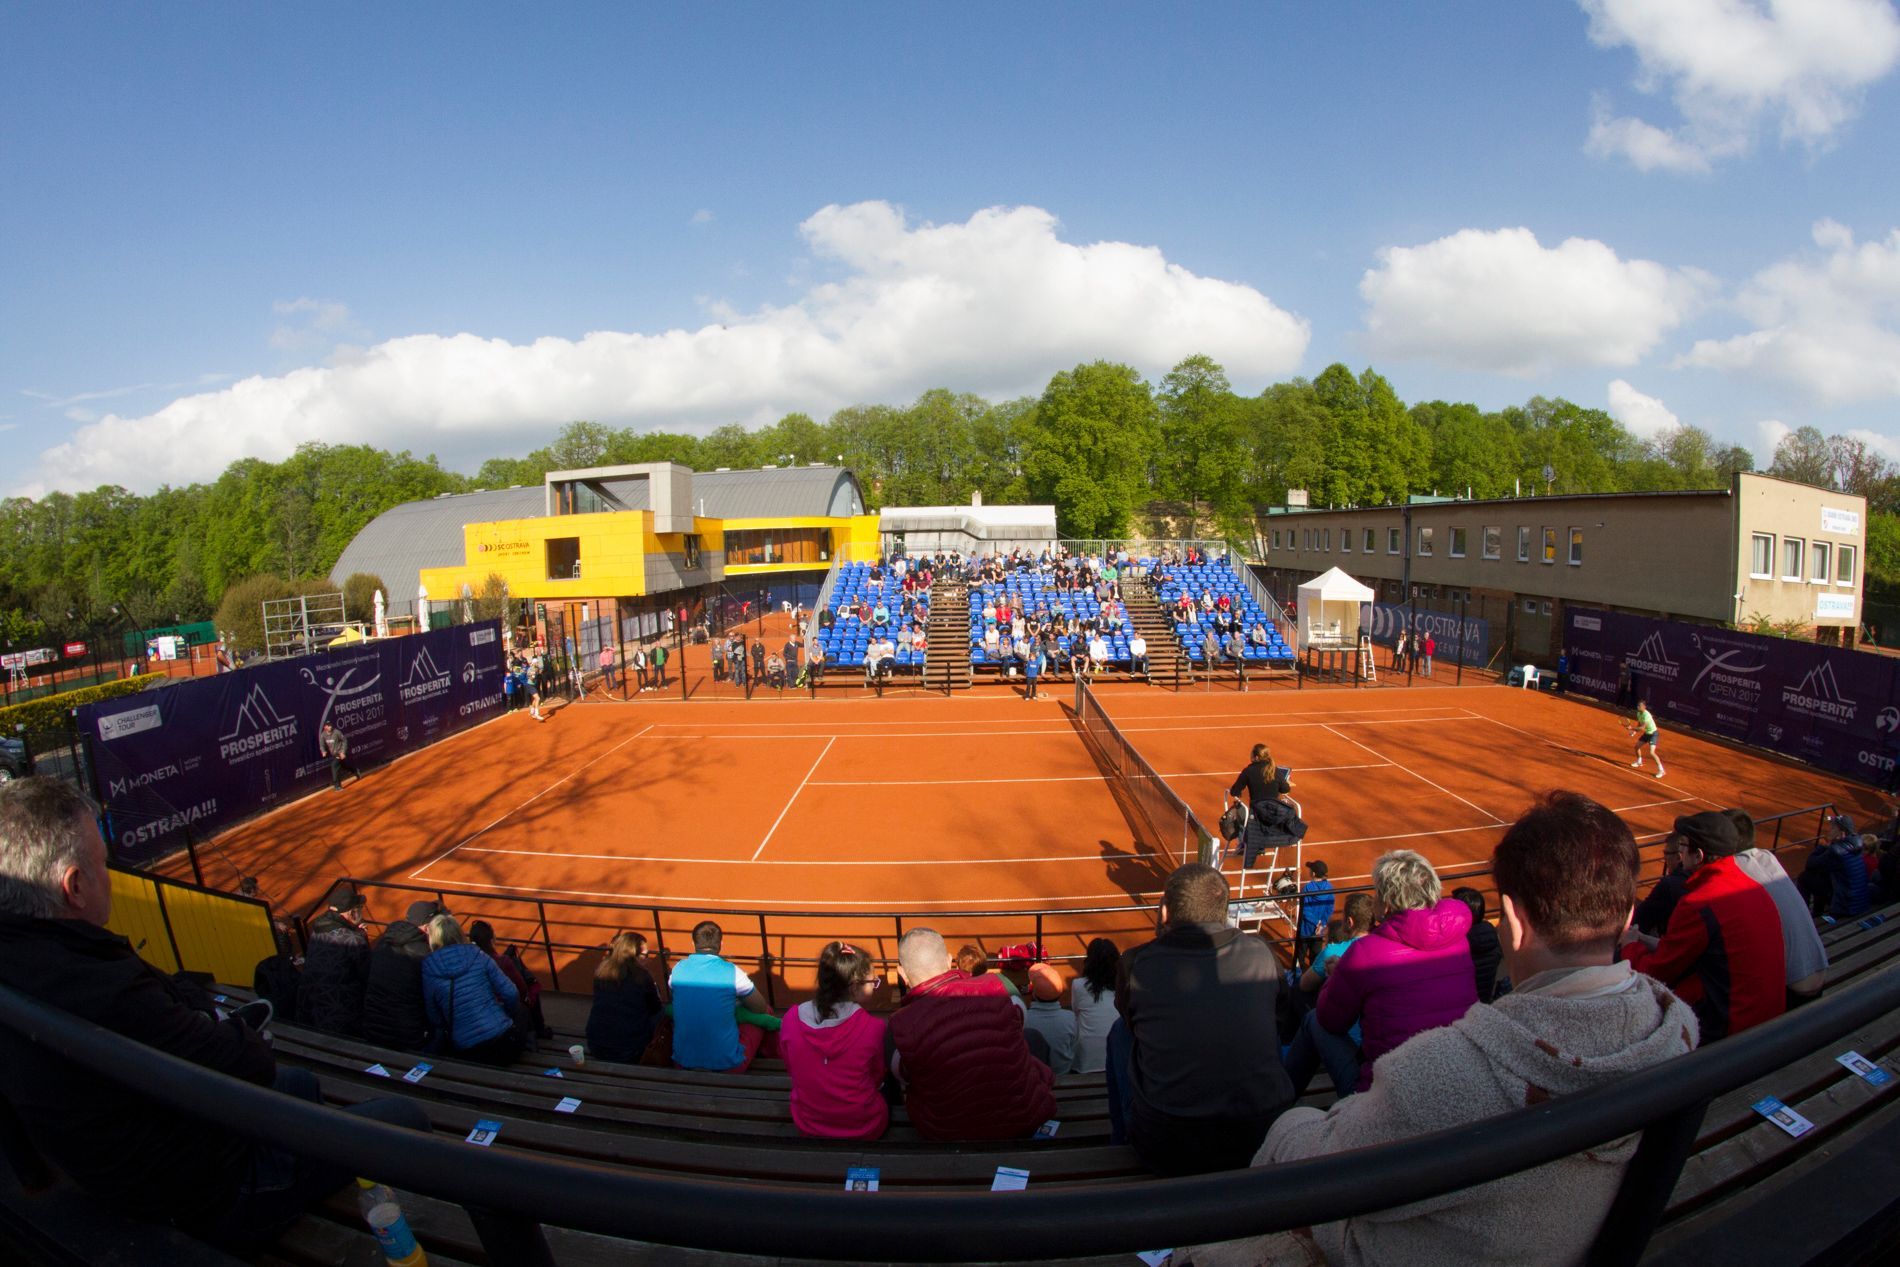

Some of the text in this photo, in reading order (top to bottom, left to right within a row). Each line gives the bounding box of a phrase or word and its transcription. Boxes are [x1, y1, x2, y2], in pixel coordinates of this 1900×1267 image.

[506, 542, 530, 550] OSTRAVA
[1424, 615, 1480, 643] OSTRAVA
[1569, 673, 1617, 693] OSTRAVA!!!
[1708, 682, 1761, 703] OPEN 2017
[116, 709, 158, 726] CHALLENGER
[118, 722, 136, 732] TOUR
[336, 711, 366, 730] OPEN
[366, 704, 385, 720] 2017
[128, 764, 179, 790] MONETA
[122, 798, 217, 848] OSTRAVA!!!
